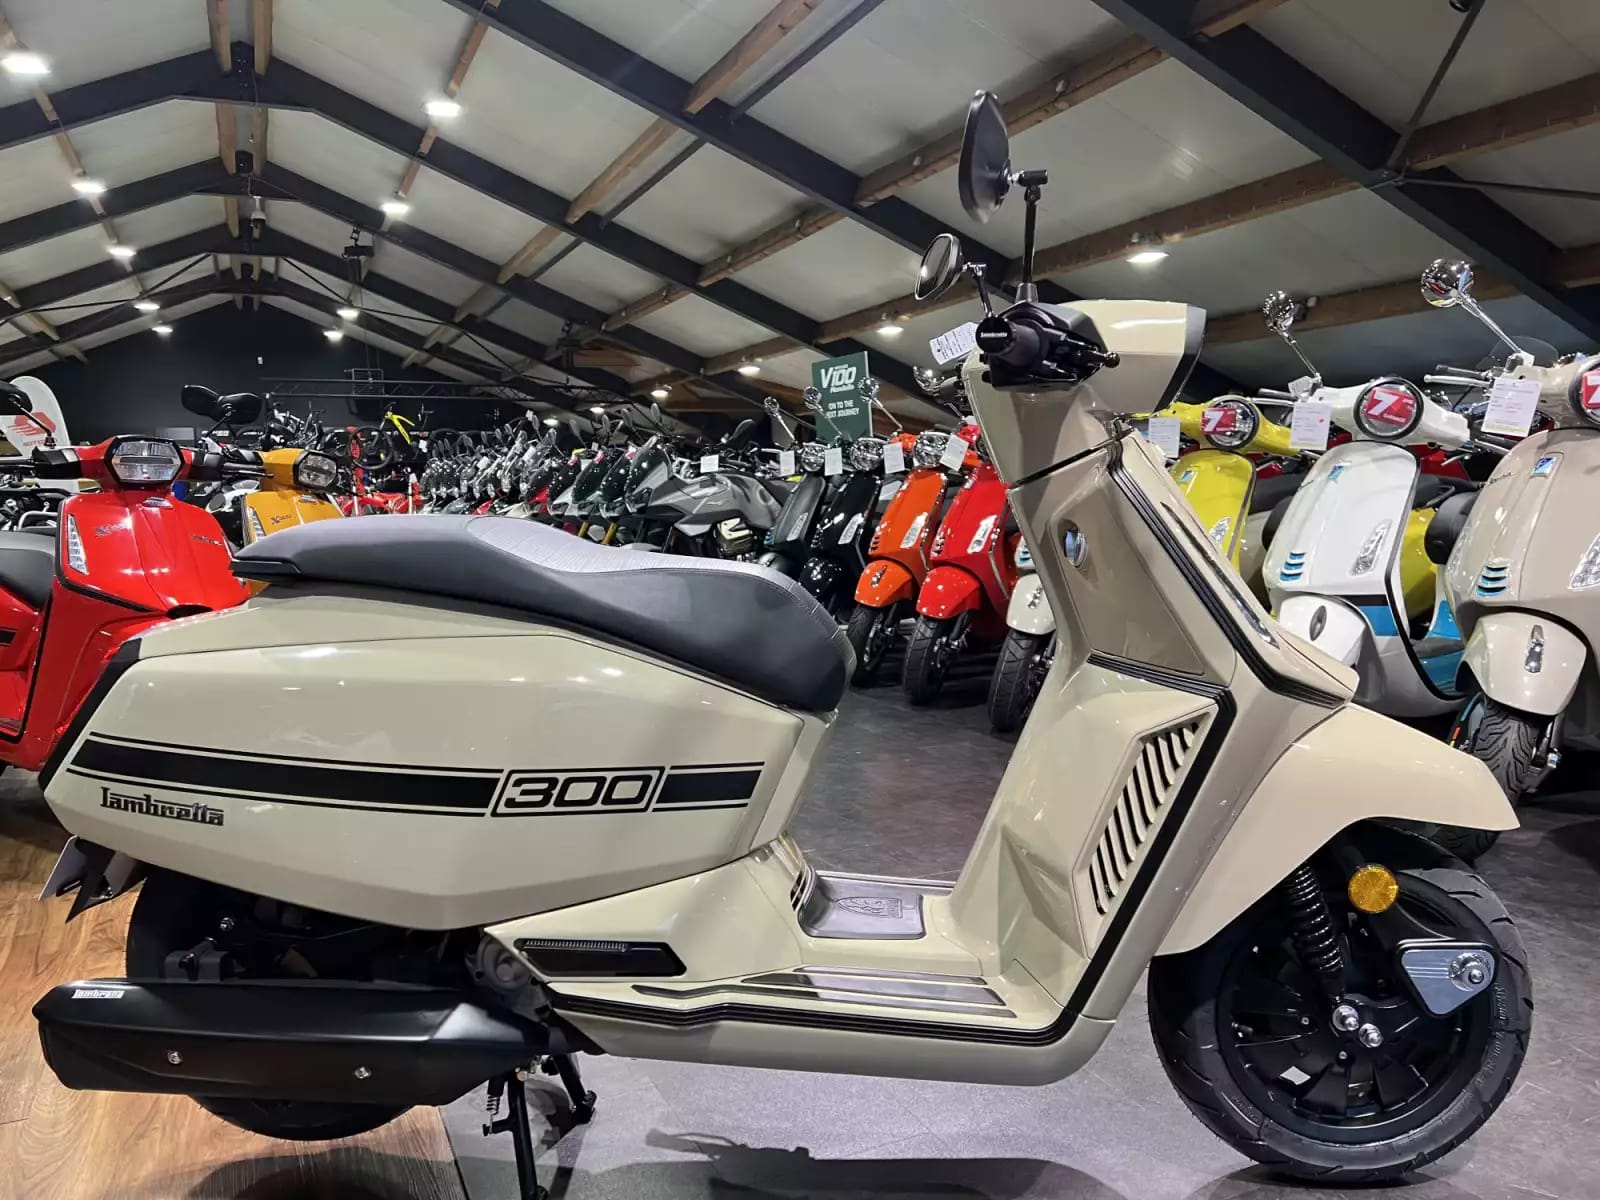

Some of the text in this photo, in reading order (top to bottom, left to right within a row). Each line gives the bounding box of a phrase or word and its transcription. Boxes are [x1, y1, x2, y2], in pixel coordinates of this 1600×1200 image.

[1368, 390, 1399, 415] 7
[1204, 410, 1224, 431] 7
[504, 774, 653, 808] 300
[100, 786, 224, 826] Lambretta
